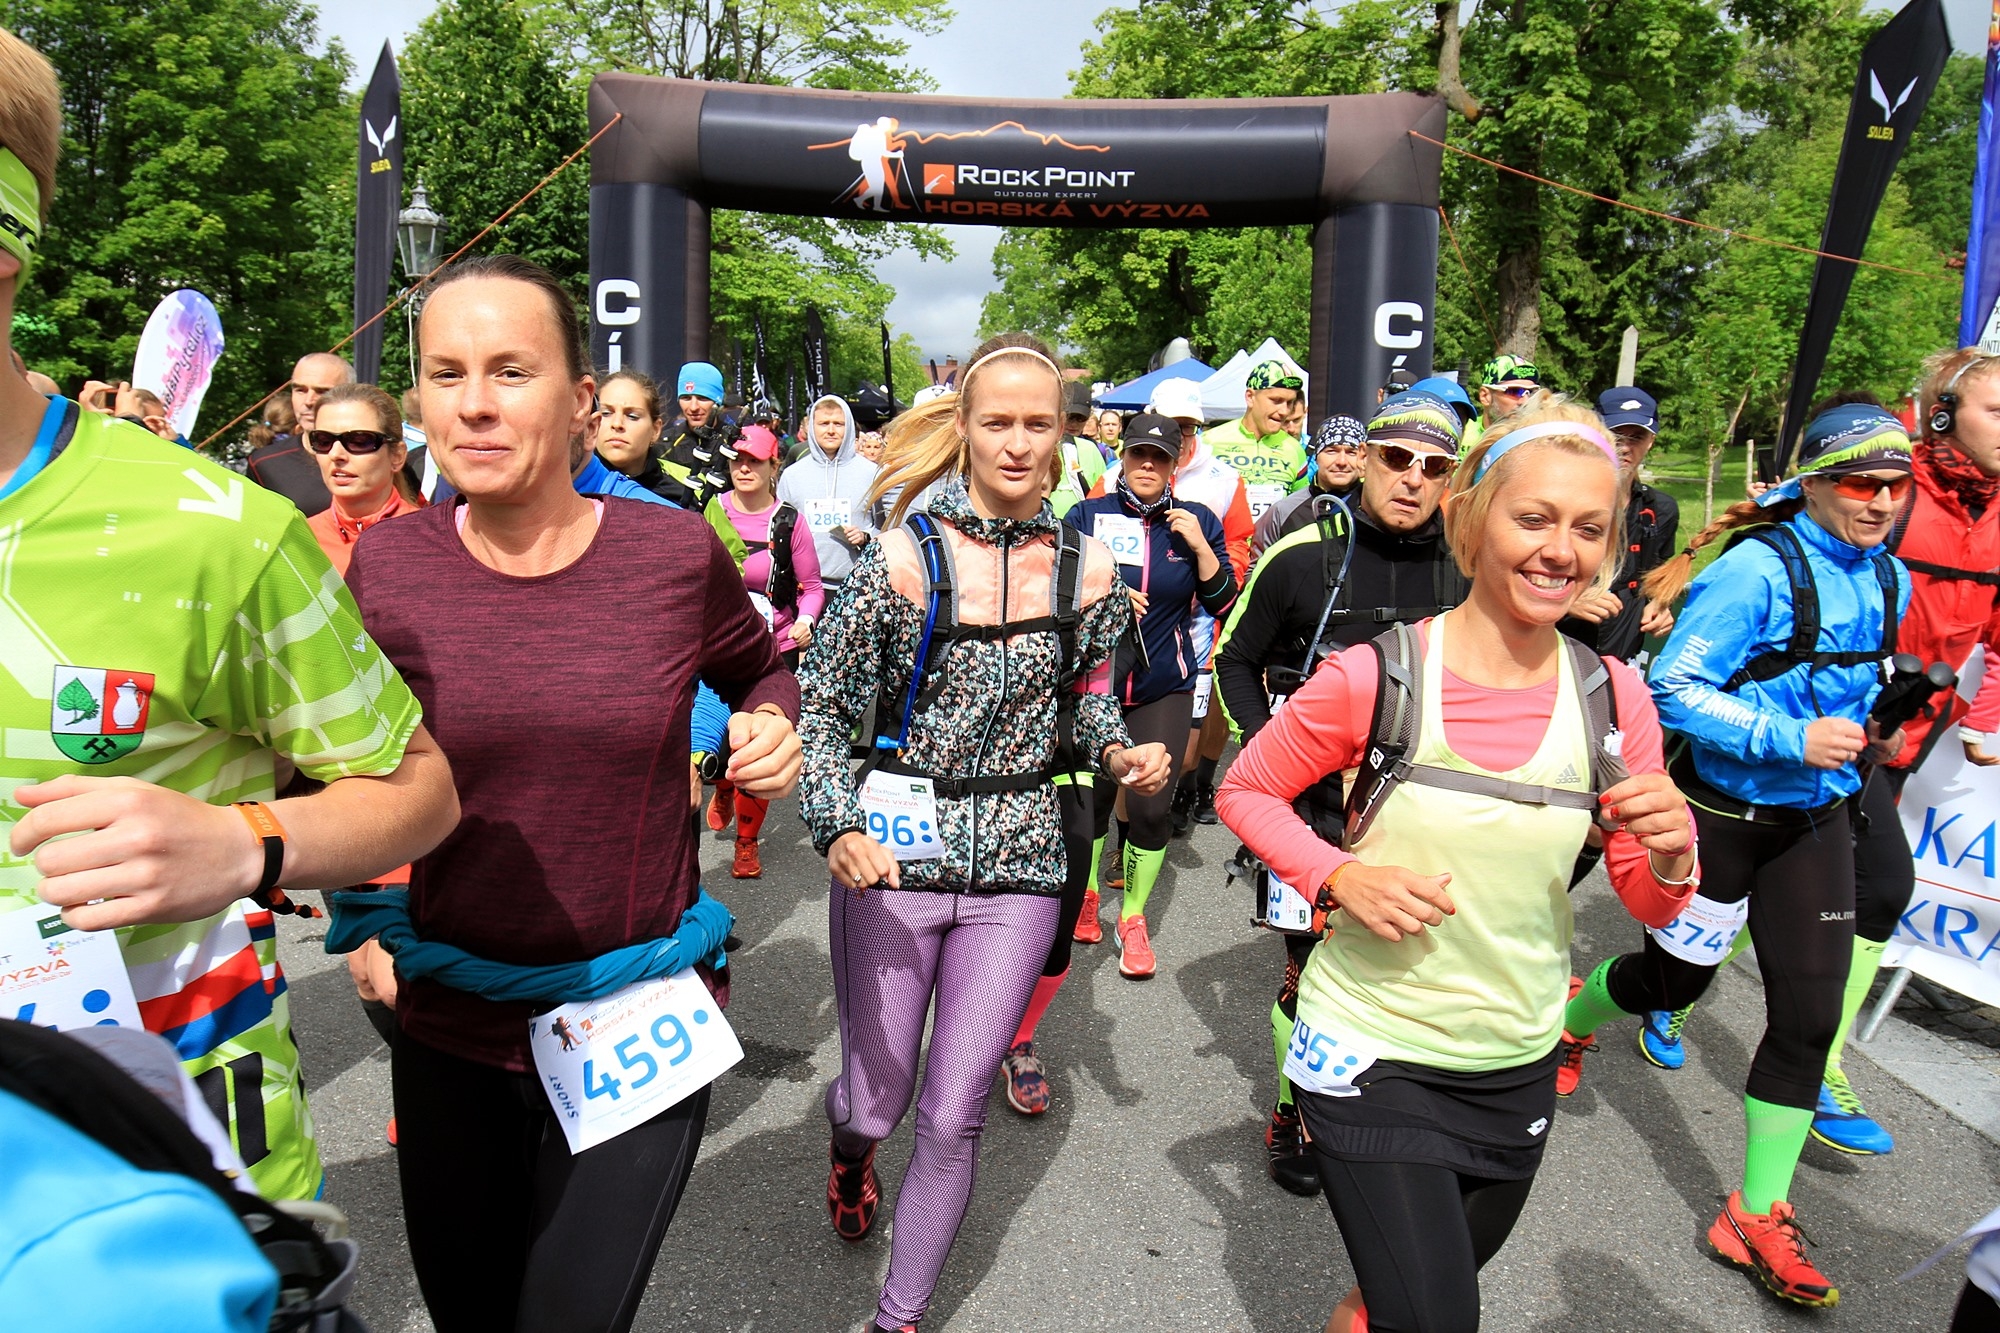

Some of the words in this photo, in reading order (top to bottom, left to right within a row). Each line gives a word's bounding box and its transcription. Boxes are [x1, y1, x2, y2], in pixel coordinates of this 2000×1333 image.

[958, 164, 1040, 187] ROCK
[1044, 166, 1136, 188] POINT
[994, 190, 1049, 198] OUTDOOR
[924, 199, 1075, 218] HORSKÁ
[1089, 200, 1210, 218] VÝZVA
[1099, 534, 1140, 554] 62
[1554, 776, 1582, 785] adidas
[868, 811, 915, 847] 96
[1912, 806, 1996, 879] KA
[583, 1014, 692, 1101] 459
[548, 1075, 579, 1119] SHORT
